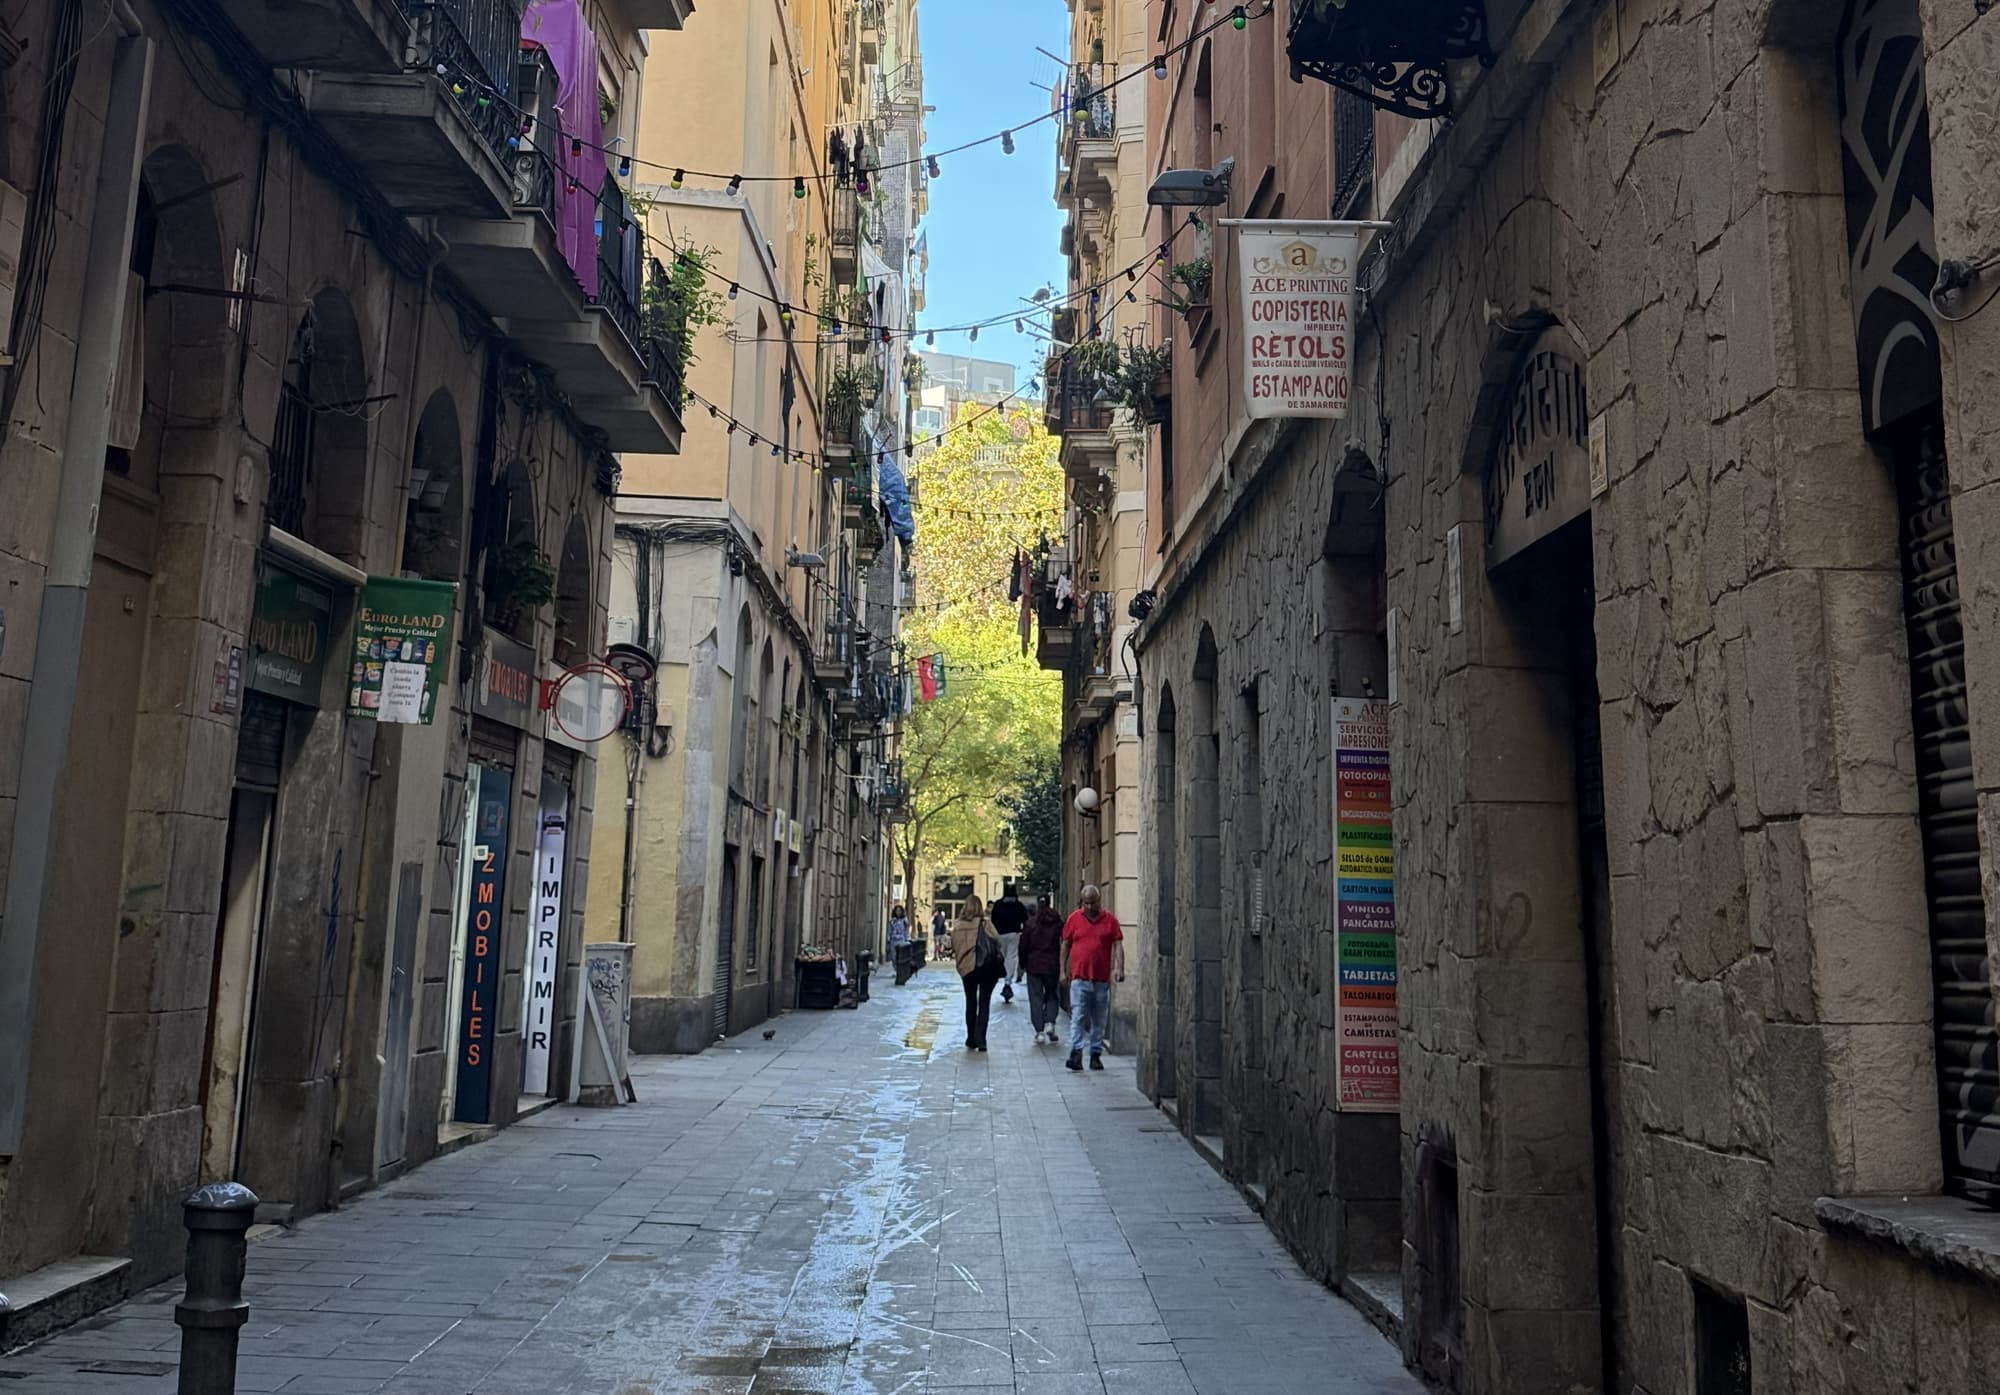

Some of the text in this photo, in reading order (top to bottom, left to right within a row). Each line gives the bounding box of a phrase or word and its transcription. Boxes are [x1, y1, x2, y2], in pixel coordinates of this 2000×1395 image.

[1292, 247, 1308, 266] a
[1252, 278, 1348, 293] ACE PRINTING
[1252, 300, 1348, 322] COPISTERIA
[1304, 324, 1345, 332] IMPREMTA
[1252, 330, 1346, 359] RÈTOLS
[1252, 372, 1348, 400] ESTAMPACIÓ
[1287, 401, 1298, 409] DE
[360, 607, 445, 629] EURO LAND
[411, 629, 438, 638] Calidad
[1340, 725, 1389, 735] SERVICIOS
[1342, 854, 1364, 863] SELLOS
[1346, 905, 1391, 914] VINILOS
[1343, 919, 1395, 929] PANCARTAS
[532, 857, 559, 1050] IMPRIMIR
[1343, 969, 1396, 981] TARJETAS
[1343, 991, 1396, 1001] TALONARIOS
[1344, 1028, 1397, 1038] CAMISETAS
[1344, 1050, 1398, 1060] CARTELES
[1344, 1064, 1398, 1075] ROTULOS
